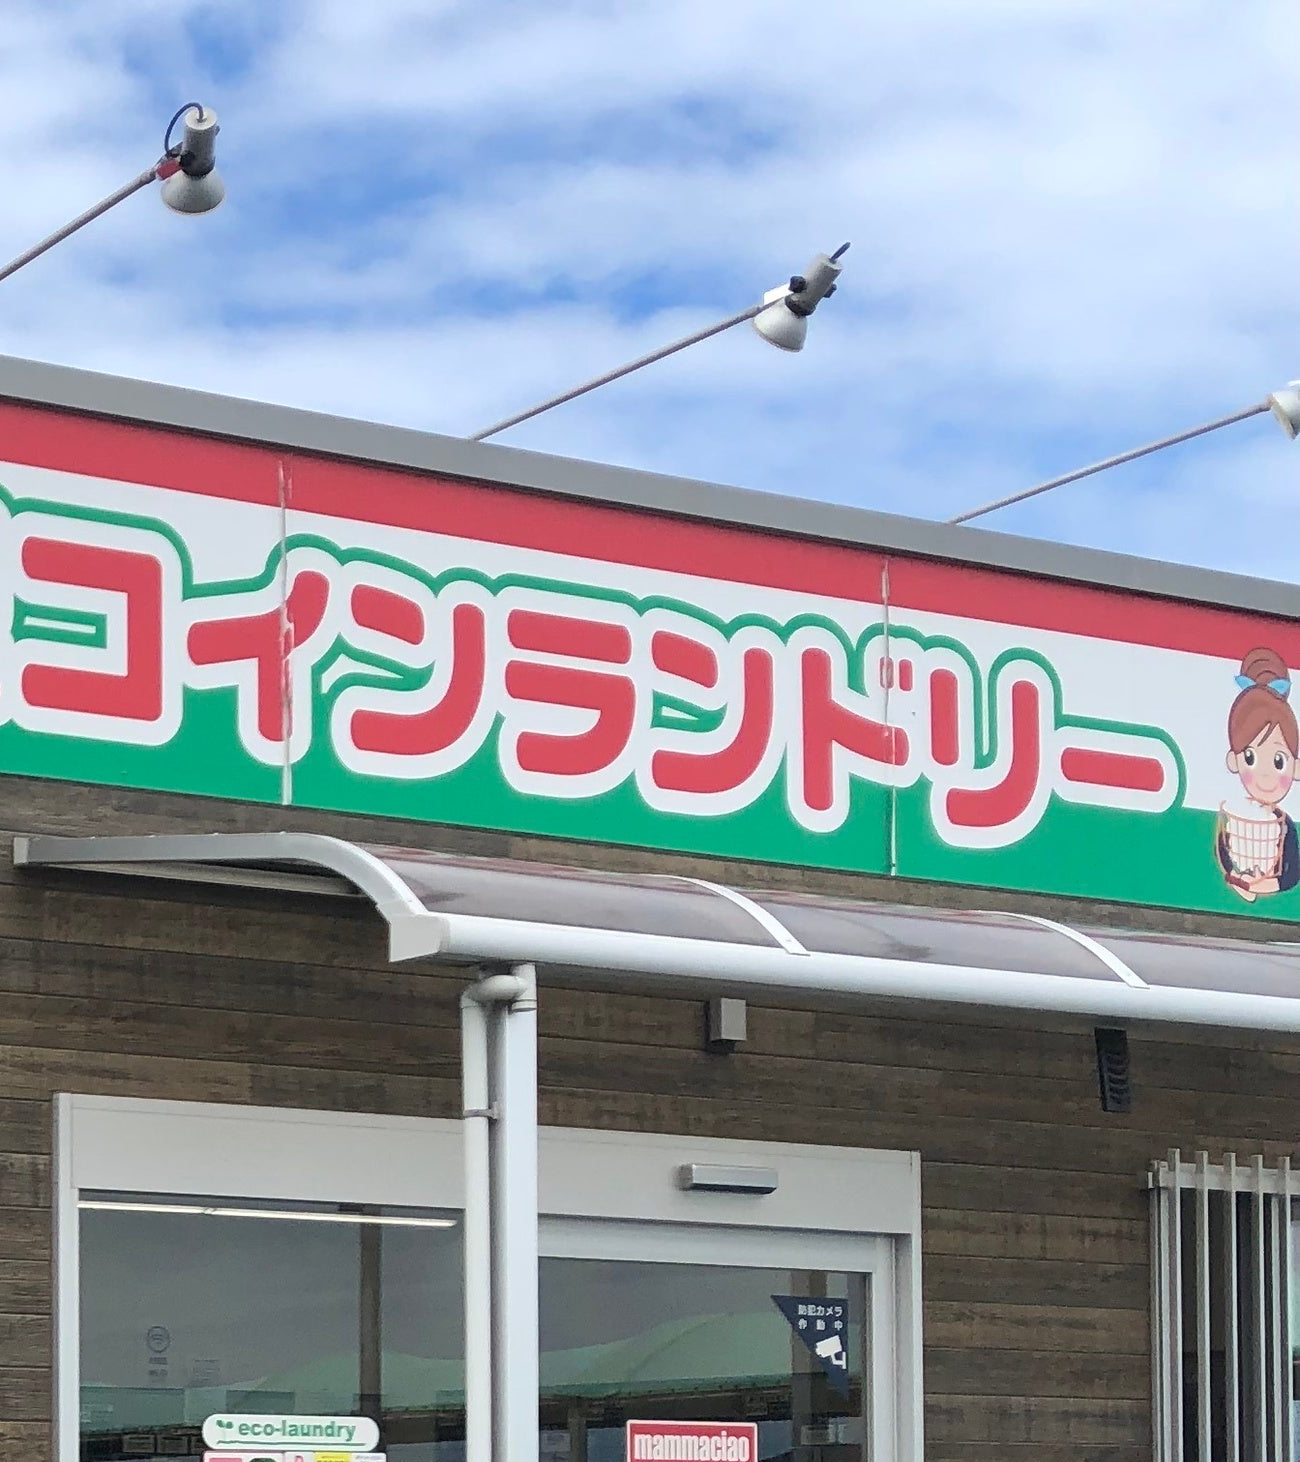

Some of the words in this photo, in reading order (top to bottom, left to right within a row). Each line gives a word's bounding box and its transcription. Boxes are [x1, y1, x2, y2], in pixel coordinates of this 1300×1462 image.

[798, 1304, 843, 1317] 防犯カメラ
[238, 1420, 356, 1442] eco-laundry
[634, 1430, 750, 1462] mammaciao
